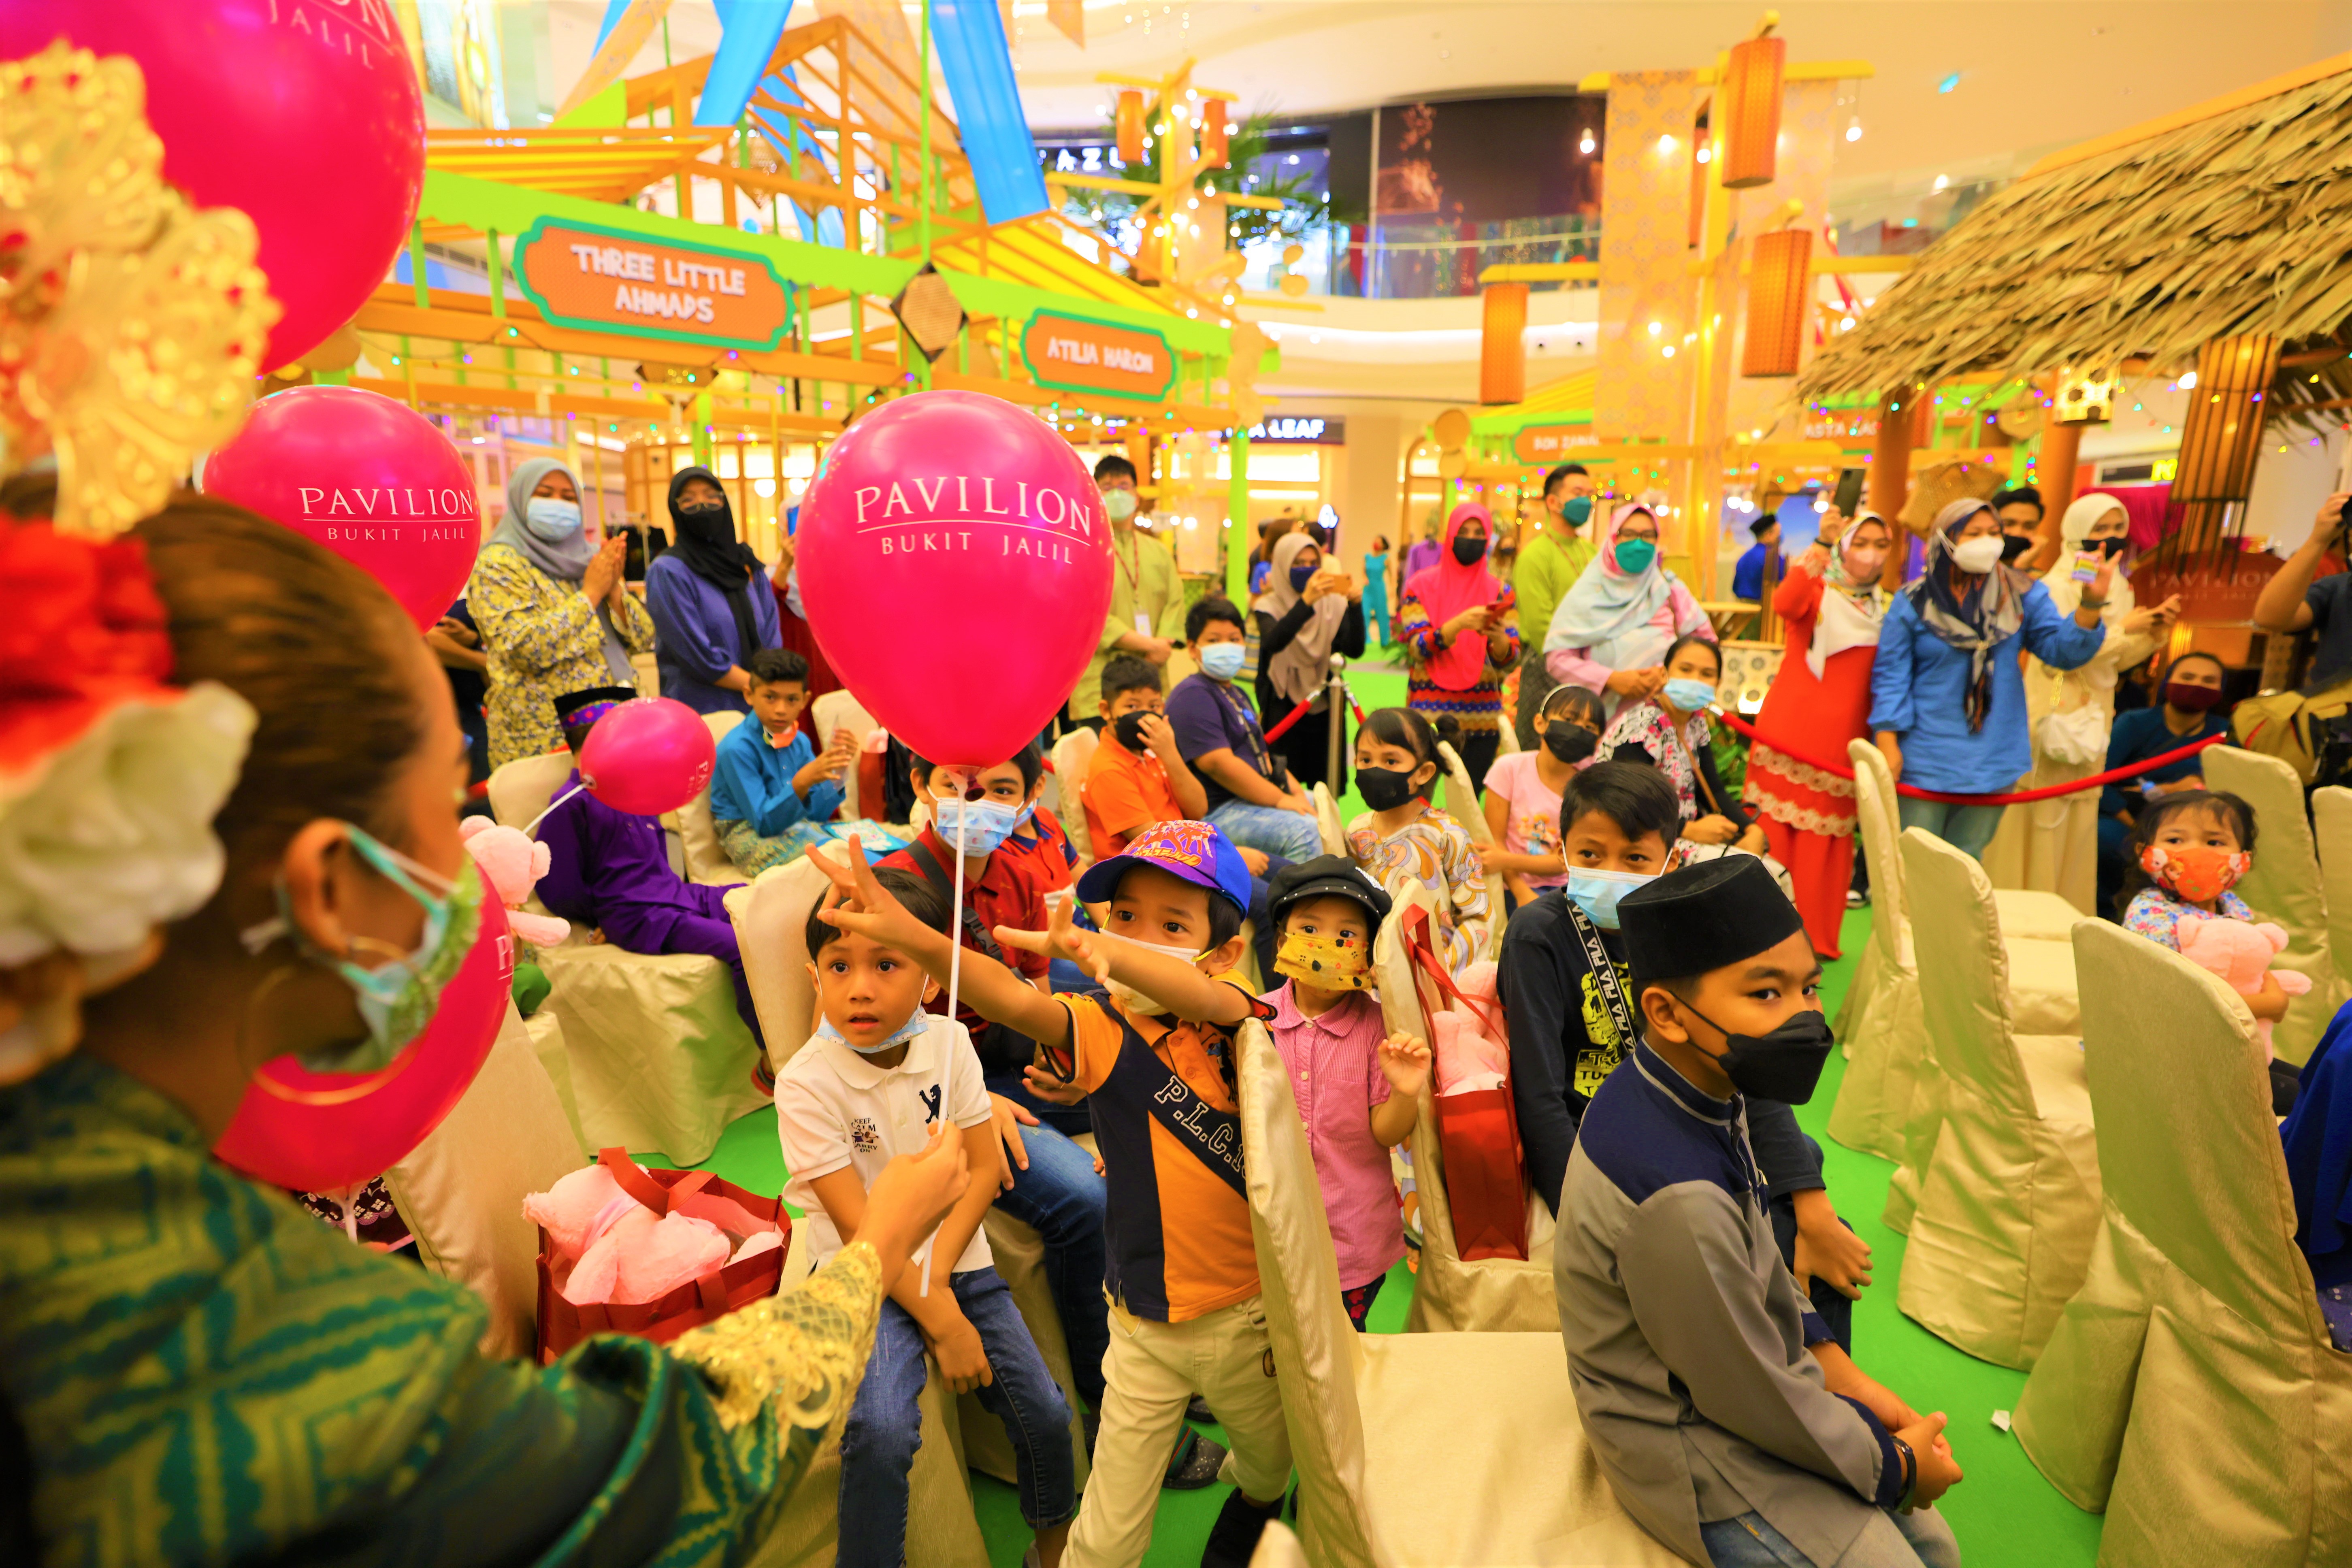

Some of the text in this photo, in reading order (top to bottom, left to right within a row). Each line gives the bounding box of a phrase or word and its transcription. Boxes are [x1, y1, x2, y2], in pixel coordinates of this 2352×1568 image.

[270, 0, 374, 70] JALIL
[570, 244, 746, 296] THREE LITTLE
[615, 285, 714, 324] AHMADS
[1047, 336, 1153, 374] ATILIA HARON
[1268, 418, 1325, 439] LEAF
[298, 487, 474, 515] PAVILION
[854, 476, 1091, 537] PAVILION
[328, 527, 465, 542] BUKIT JALIL
[882, 532, 1072, 564] BUKIT JALIL
[1587, 937, 1606, 967] FILA
[1600, 969, 1618, 999] FILA
[1611, 1003, 1629, 1031] FILA
